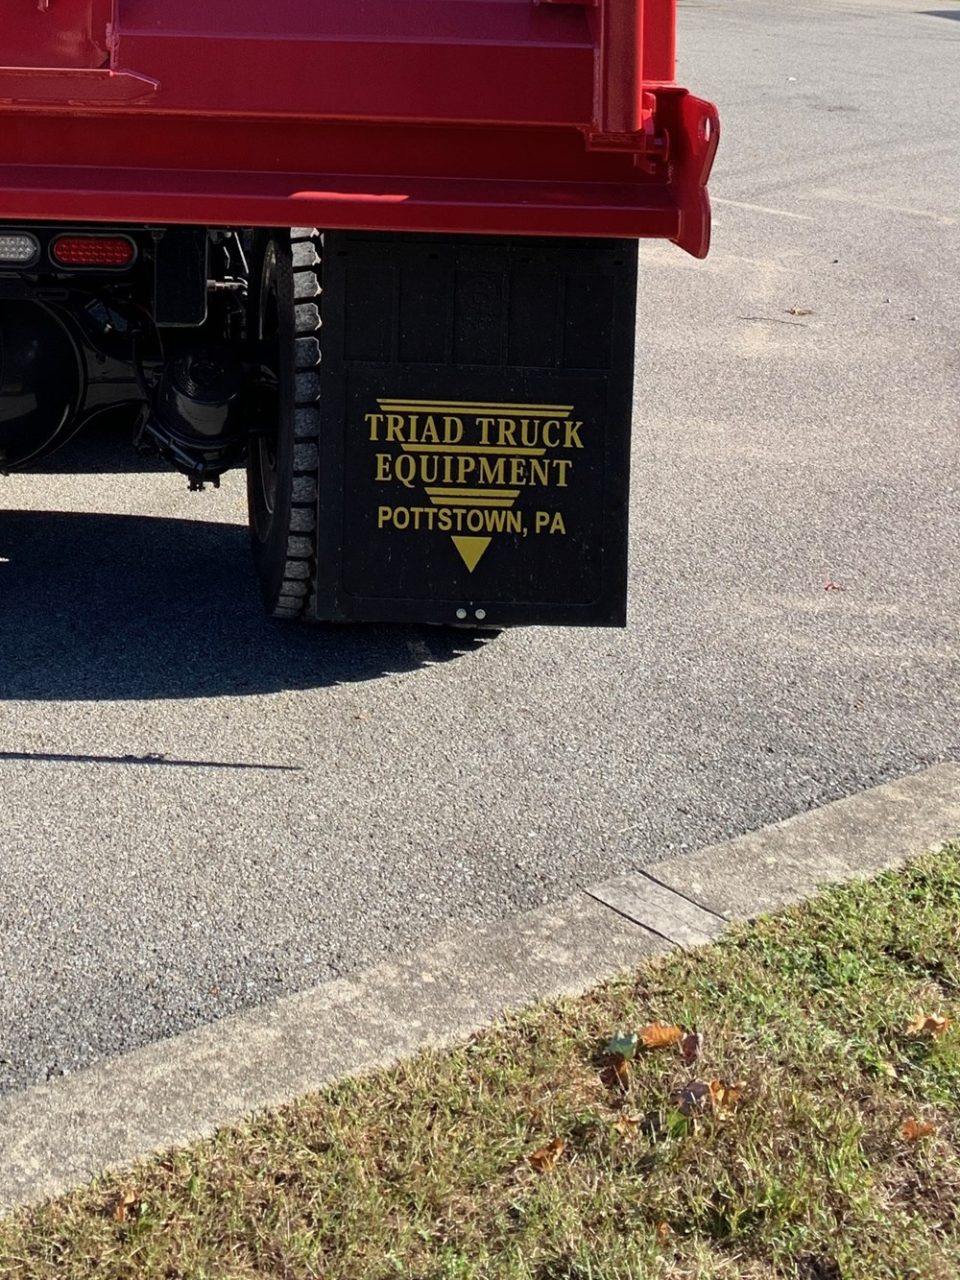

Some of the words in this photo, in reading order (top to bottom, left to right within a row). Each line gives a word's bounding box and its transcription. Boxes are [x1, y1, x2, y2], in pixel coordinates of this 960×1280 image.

[365, 413, 464, 443] TRIAD
[476, 418, 584, 448] TRUCK
[375, 453, 573, 488] EQUIPMENT
[378, 505, 528, 537] POTTSTOWN,
[535, 511, 566, 535] PA
